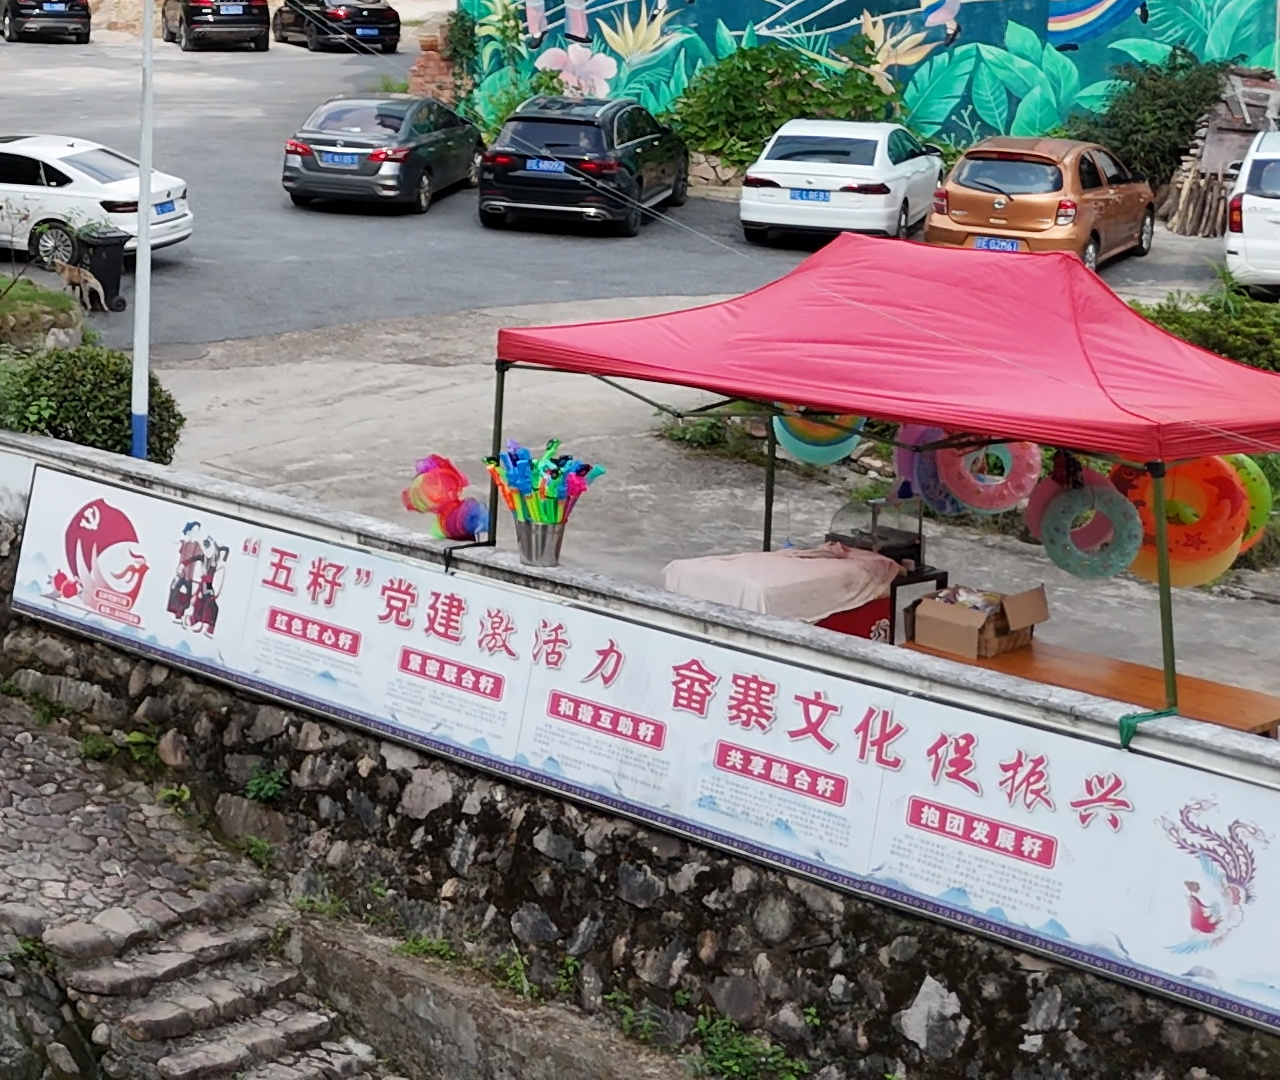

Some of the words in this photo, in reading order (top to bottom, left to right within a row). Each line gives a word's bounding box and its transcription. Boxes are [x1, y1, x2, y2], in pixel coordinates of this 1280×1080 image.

[242, 537, 626, 686] “五籽”党建激活力
[670, 658, 1133, 830] 畲寨文化促振兴
[725, 749, 837, 798] 共享融合籽
[920, 804, 1043, 859] 抱团发展籽
